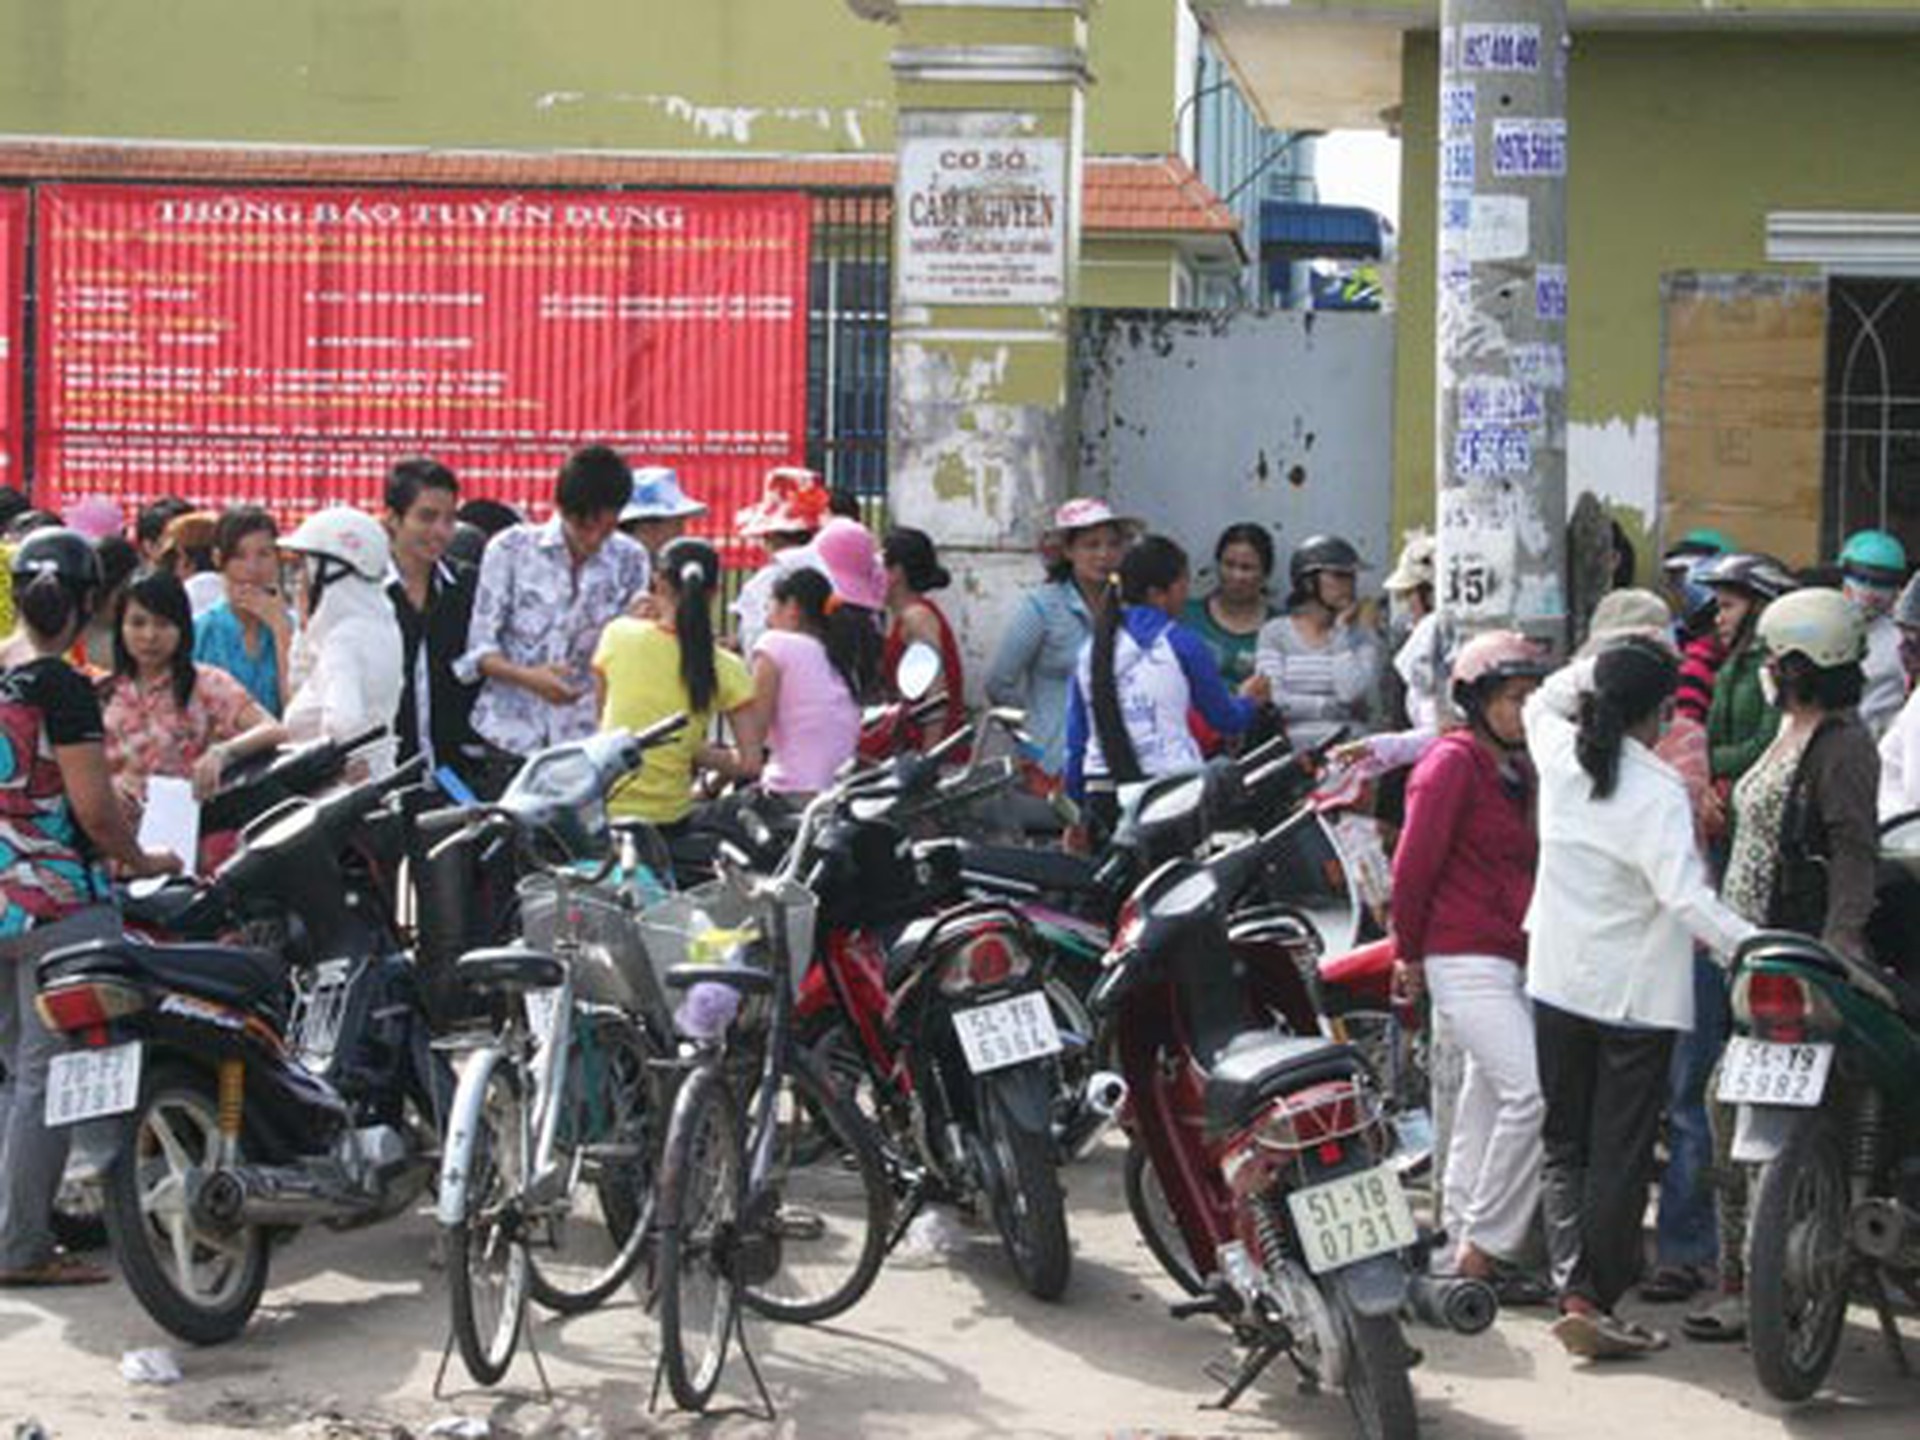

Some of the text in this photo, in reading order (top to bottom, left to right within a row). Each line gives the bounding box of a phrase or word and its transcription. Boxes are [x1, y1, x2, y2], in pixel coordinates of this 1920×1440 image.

[158, 196, 301, 223] THÔNG
[313, 197, 400, 224] BÁO
[1307, 1176, 1388, 1226] 51-Y8
[1319, 1211, 1397, 1262] 0731
